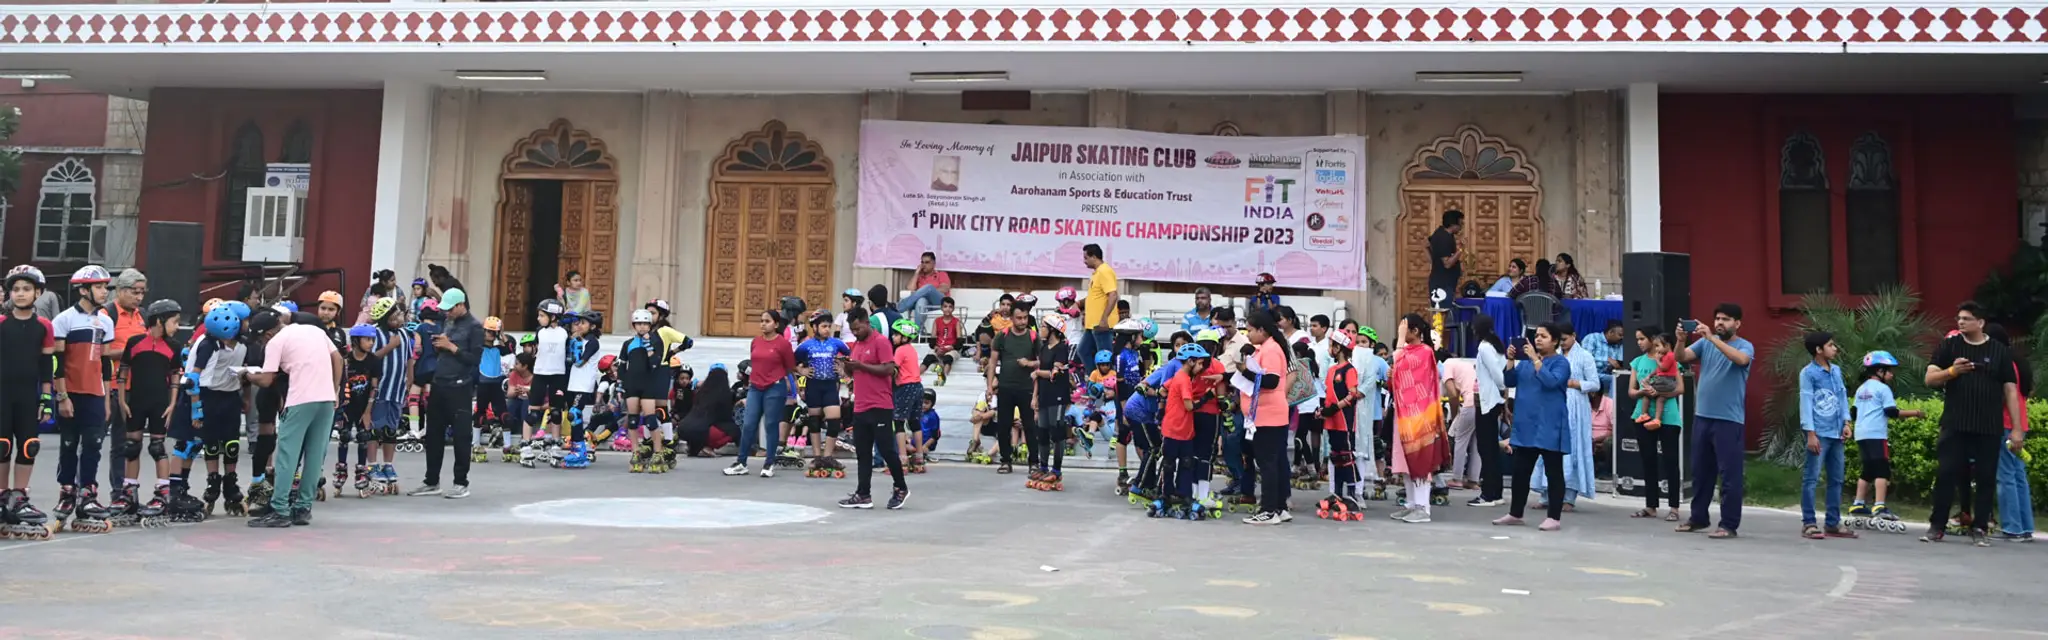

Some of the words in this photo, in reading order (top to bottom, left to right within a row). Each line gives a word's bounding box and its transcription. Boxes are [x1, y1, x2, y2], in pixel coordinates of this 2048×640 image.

[900, 139, 911, 149] In
[915, 140, 944, 153] Loving
[946, 141, 984, 155] Memory
[986, 144, 995, 155] of
[1011, 142, 1072, 164] JAIPUR
[1076, 144, 1148, 167] SKATING
[1153, 147, 1196, 168] CLUB
[1325, 160, 1346, 168] Fortis
[1059, 170, 1067, 180] in
[1070, 171, 1123, 182] Association
[1125, 172, 1144, 183] with
[1011, 185, 1066, 197] Aarohanam
[1069, 187, 1100, 200] Sports
[1103, 188, 1112, 198] &
[1114, 189, 1163, 201] Education
[1166, 191, 1192, 202] Trust
[1081, 204, 1118, 214] PRESENTS
[1244, 205, 1294, 220] INDIA
[912, 209, 926, 229] 1st
[929, 213, 966, 231] PINK
[971, 215, 1004, 232] CITY
[1008, 216, 1050, 234] ROAD
[1054, 219, 1121, 238] SKATING
[1126, 221, 1250, 243] CHAMPIONSHIP
[1253, 227, 1294, 245] 2023
